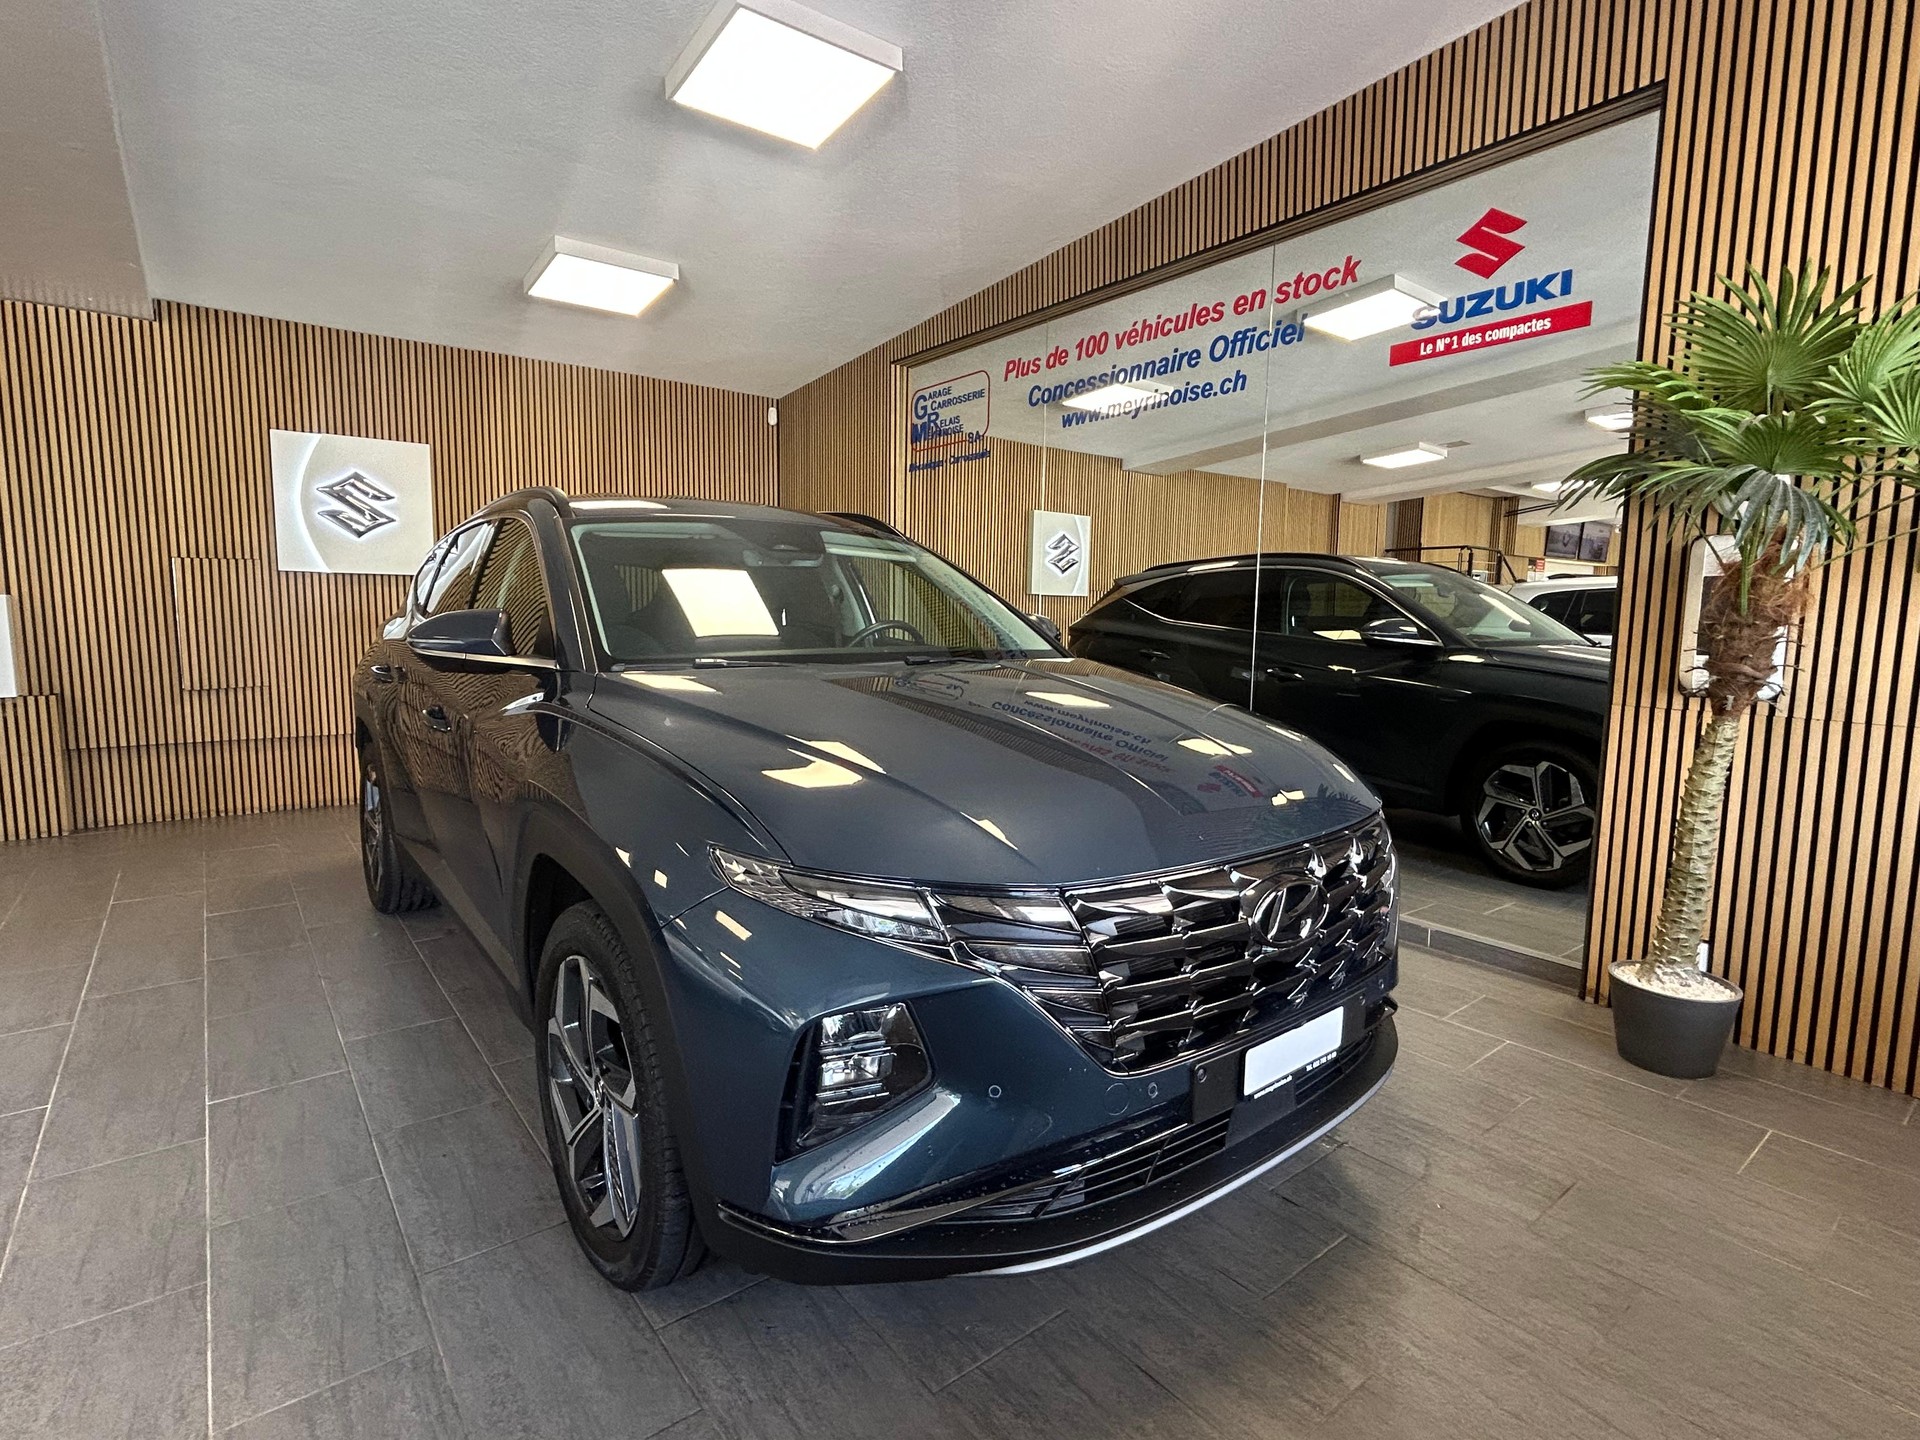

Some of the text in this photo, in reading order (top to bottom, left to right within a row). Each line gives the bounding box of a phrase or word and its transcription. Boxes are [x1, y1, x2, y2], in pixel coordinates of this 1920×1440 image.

[1004, 255, 1362, 382] Plus de 100 véhicules en stock
[1411, 269, 1573, 330] SUZUKI
[1028, 313, 1309, 408] Concessionnaire Officiel
[1420, 342, 1433, 356] Le
[1461, 332, 1482, 348] des
[1485, 317, 1552, 341] compactes
[914, 386, 953, 420] GARAGE
[930, 389, 986, 411] CARROSSERIE
[1061, 369, 1248, 428] www.meyrinoise.ch
